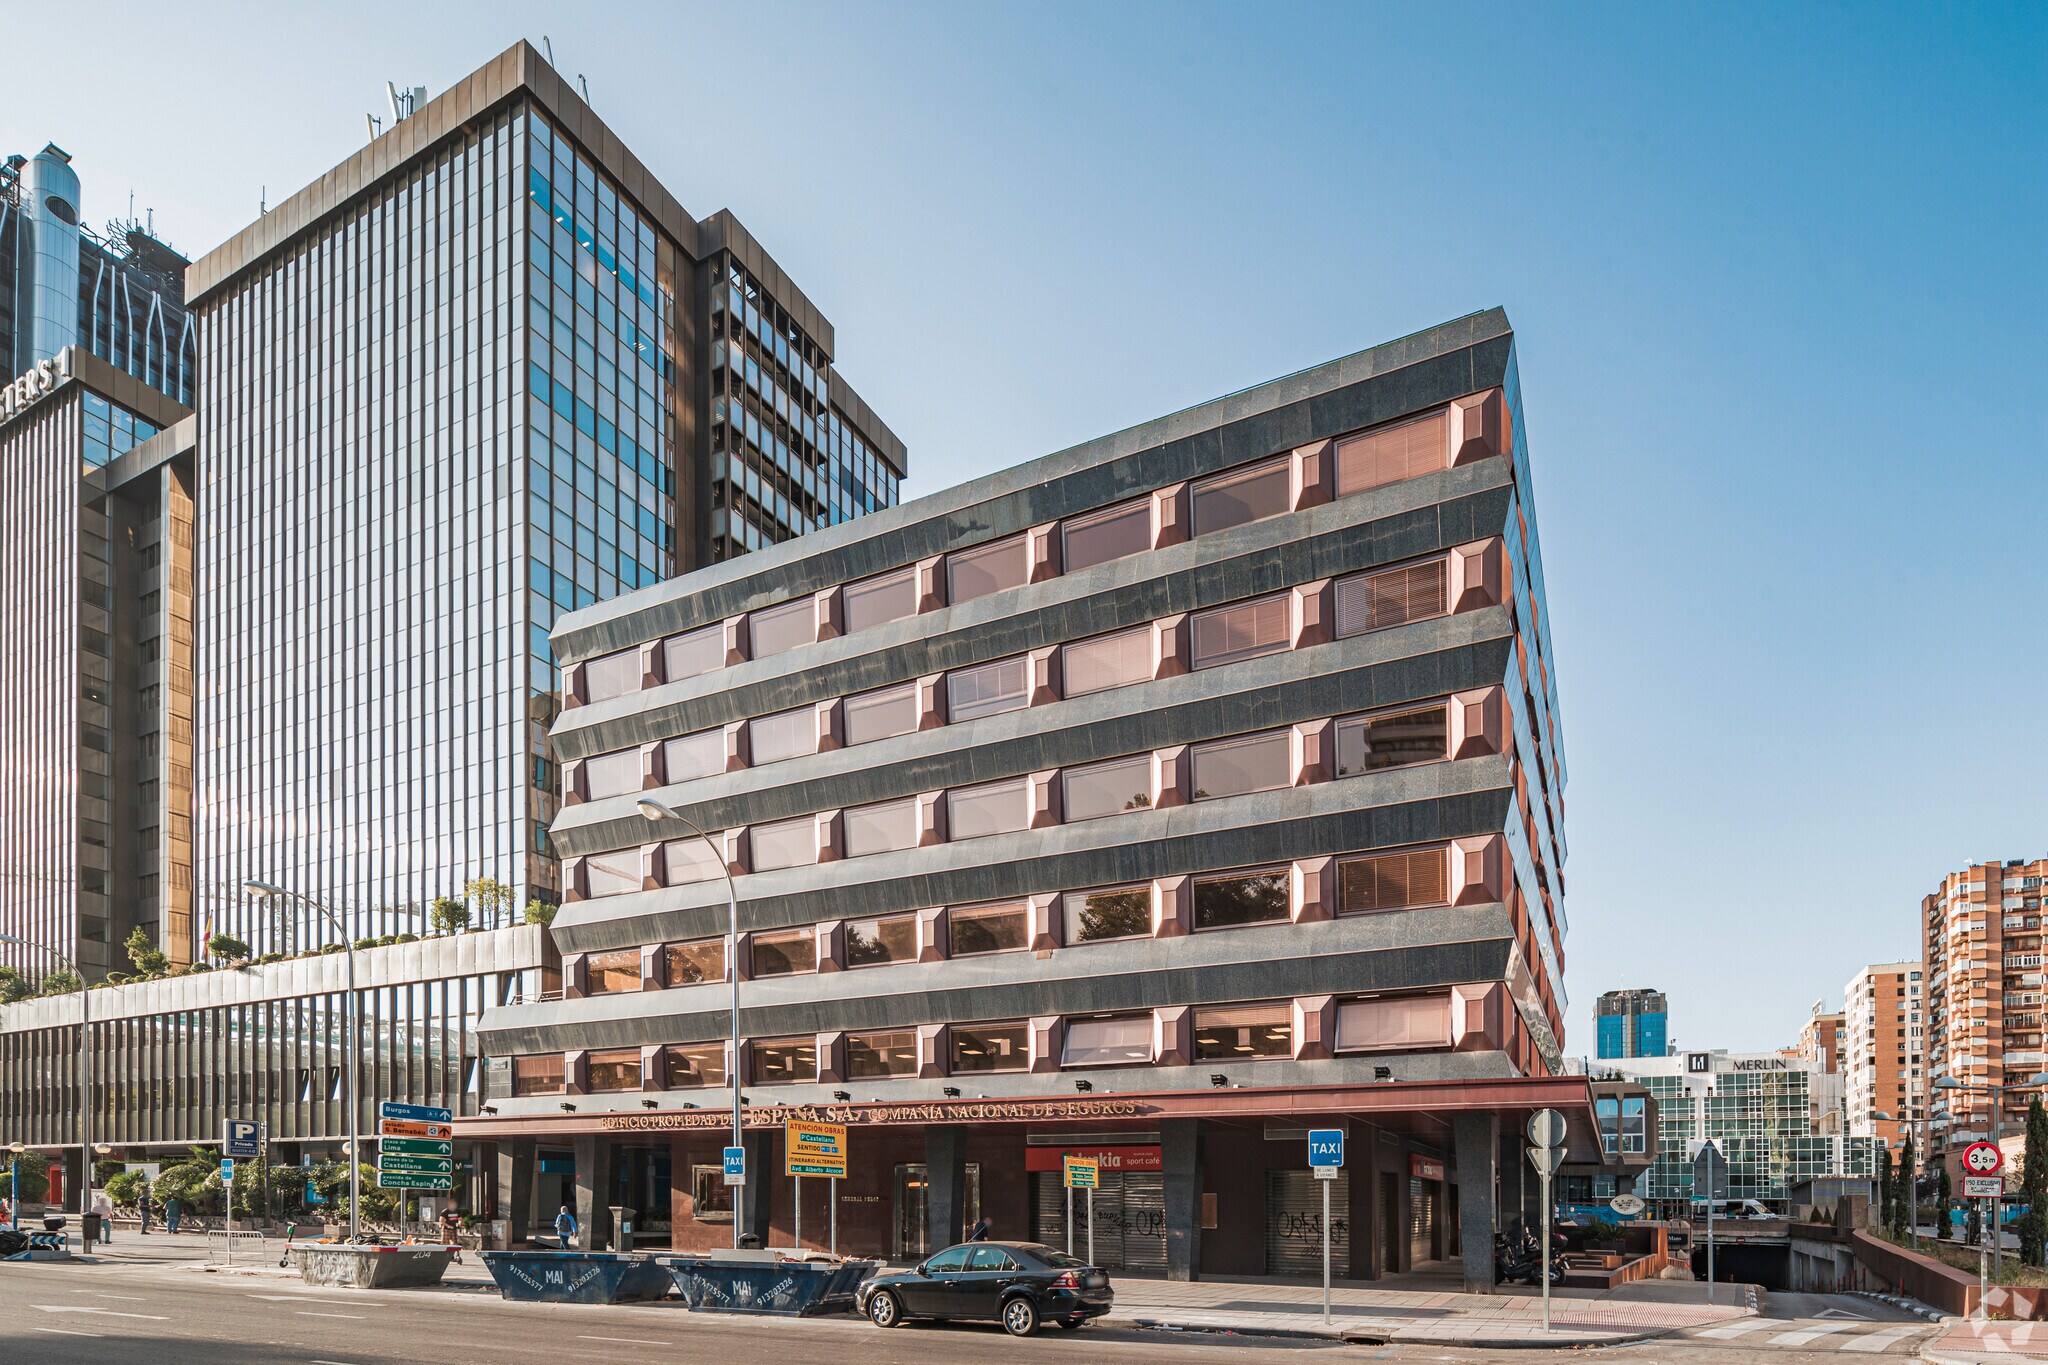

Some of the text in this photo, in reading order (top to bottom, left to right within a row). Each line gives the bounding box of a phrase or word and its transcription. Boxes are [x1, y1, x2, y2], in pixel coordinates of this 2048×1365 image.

[1733, 1059, 1787, 1071] MERLIN
[385, 1106, 411, 1114] Burgos
[600, 1116, 649, 1129] EDIFICIO
[651, 1113, 717, 1127] PROPIEDAD
[868, 1104, 945, 1121] COMPAÑÍA
[947, 1103, 1029, 1119] NACIONAL
[1033, 1103, 1055, 1117] DE
[1060, 1100, 1135, 1116] SEGUROS
[235, 1123, 255, 1139] P
[825, 1126, 845, 1135] OBRAS
[797, 1144, 821, 1152] SENTIDO
[1311, 1143, 1341, 1154] TAXI
[383, 1162, 422, 1170] Castellana
[725, 1157, 743, 1166] TAXI
[1126, 1158, 1144, 1166] sport
[1145, 1156, 1160, 1165] café
[412, 1251, 431, 1259] 204
[509, 1264, 544, 1292] 917425577
[567, 1266, 601, 1293] 913203326
[757, 1277, 794, 1306] 913203326
